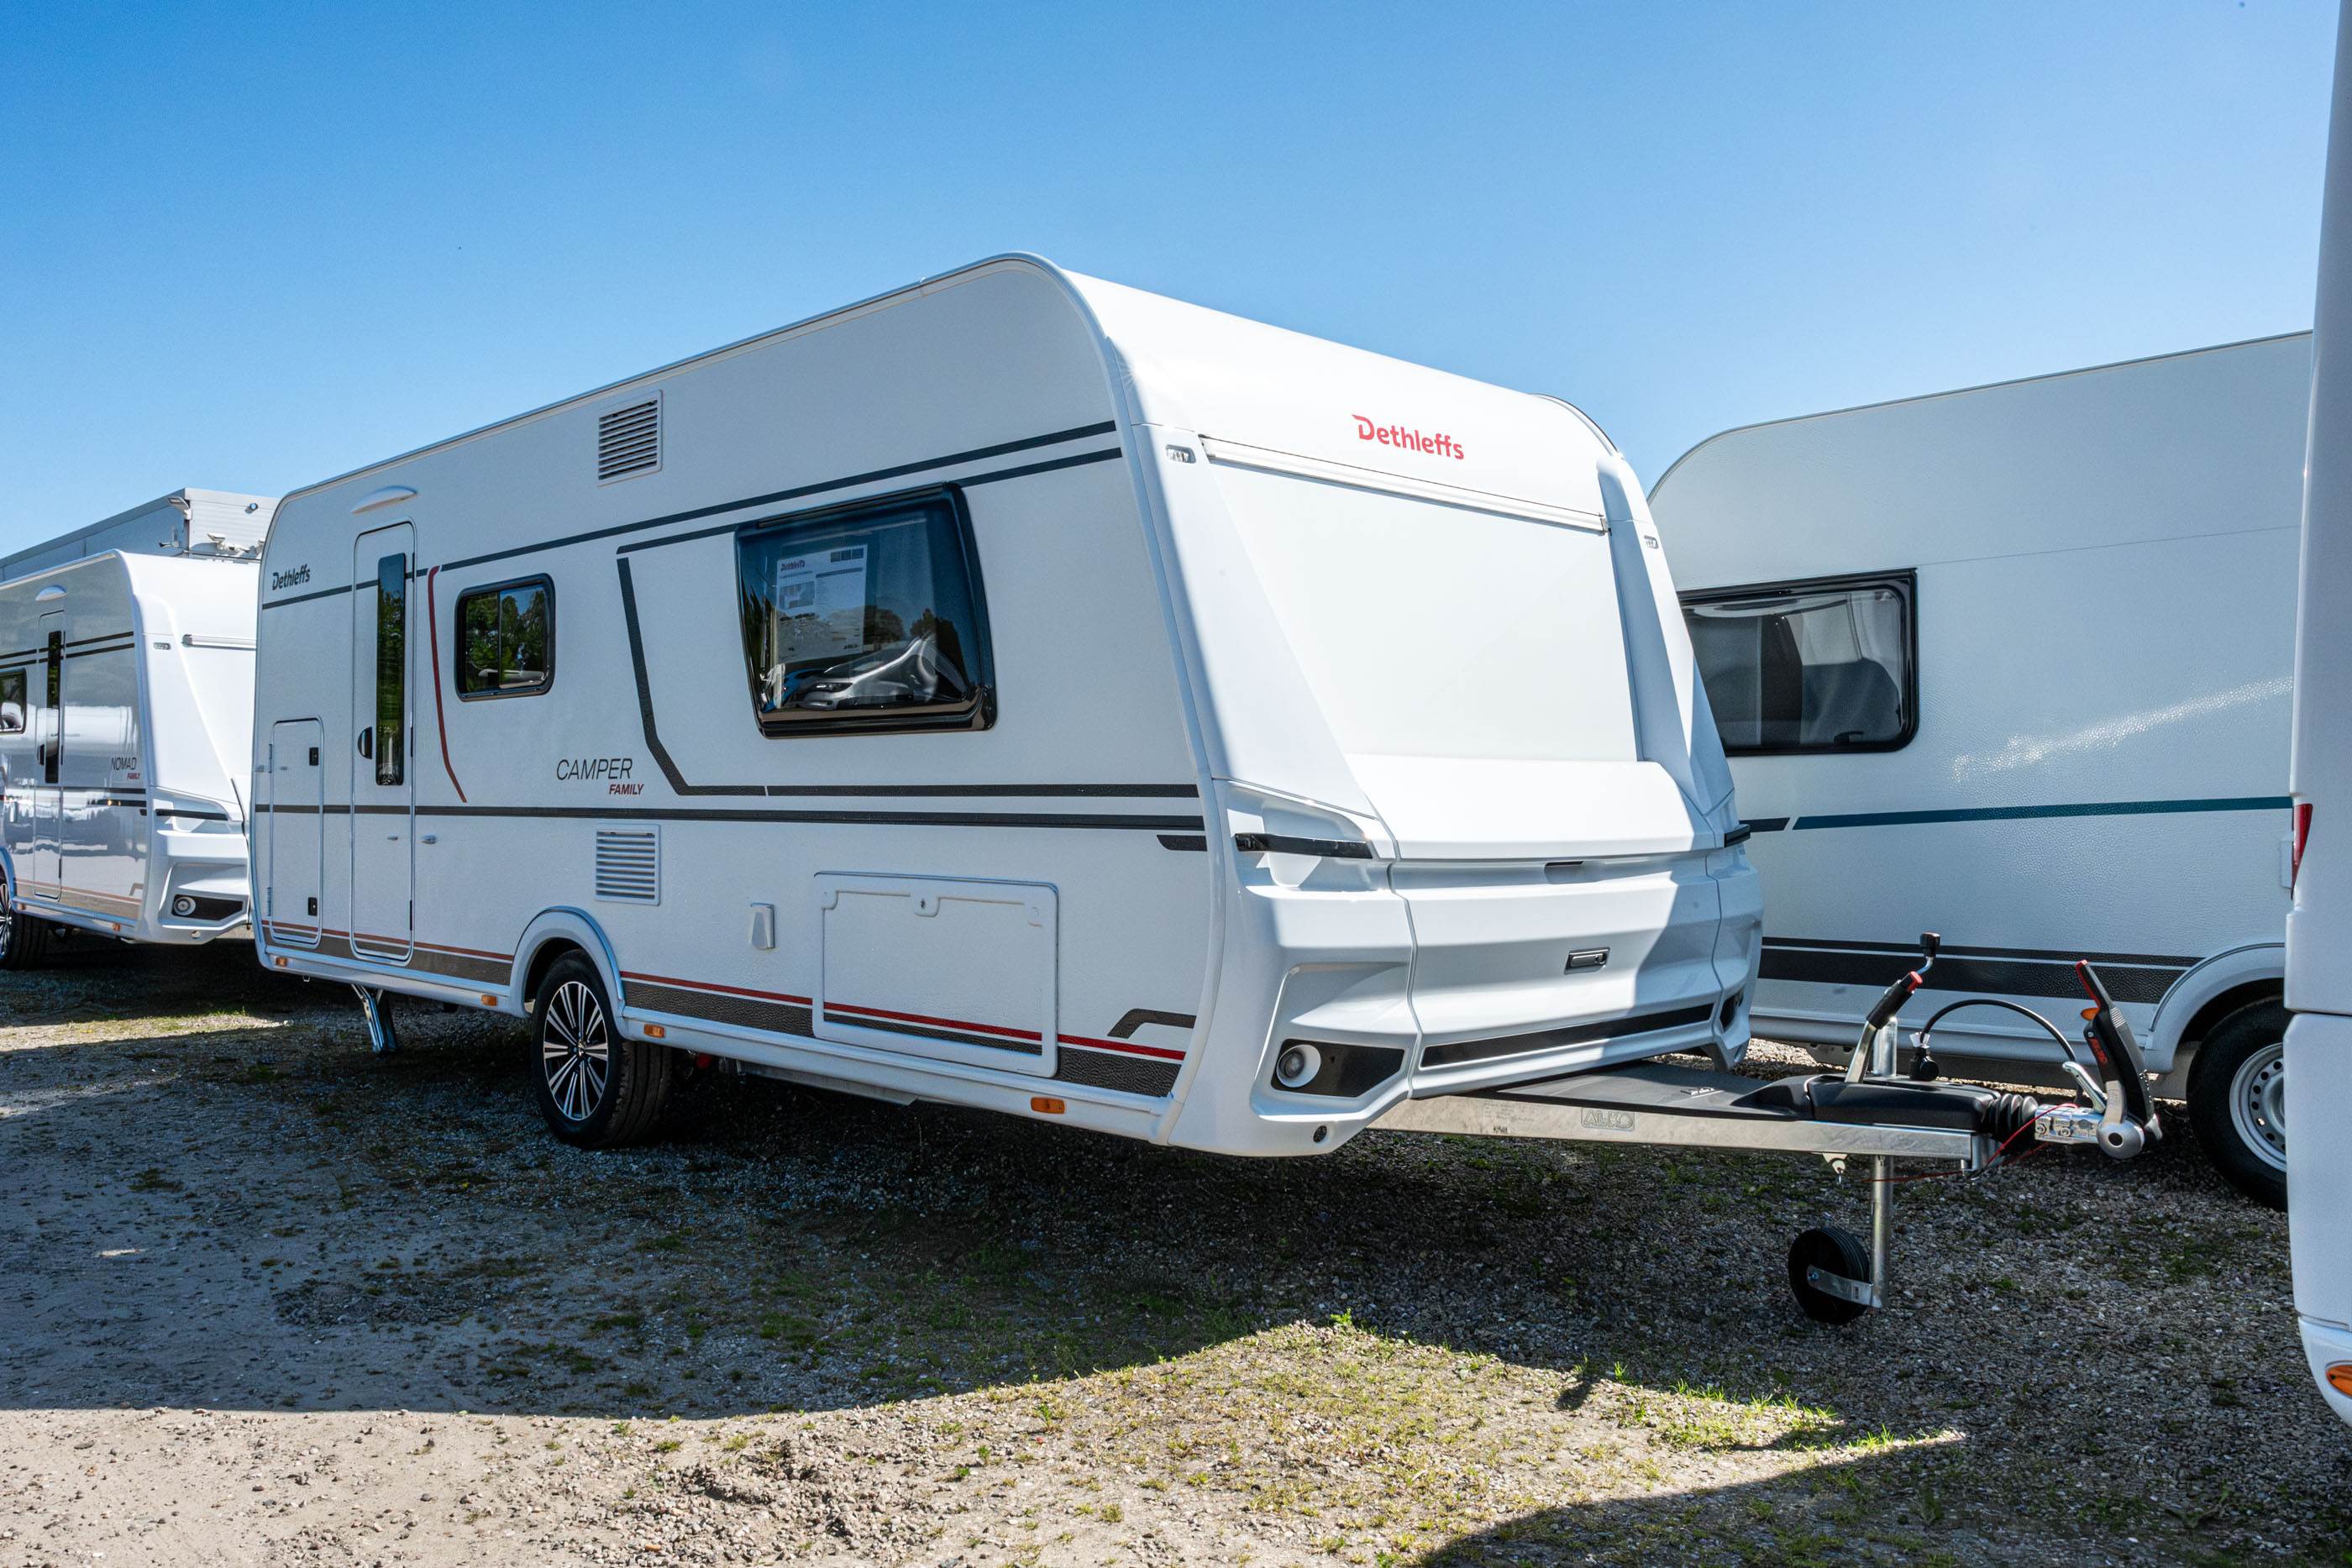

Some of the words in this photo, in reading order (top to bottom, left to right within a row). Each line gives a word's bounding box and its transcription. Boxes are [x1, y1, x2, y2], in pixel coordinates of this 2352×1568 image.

[1352, 414, 1464, 459] Dethleffs
[272, 564, 310, 590] Dethleffs
[111, 757, 137, 770] NOMAD
[556, 758, 633, 780] CAMPER
[608, 784, 644, 795] FAMILY
